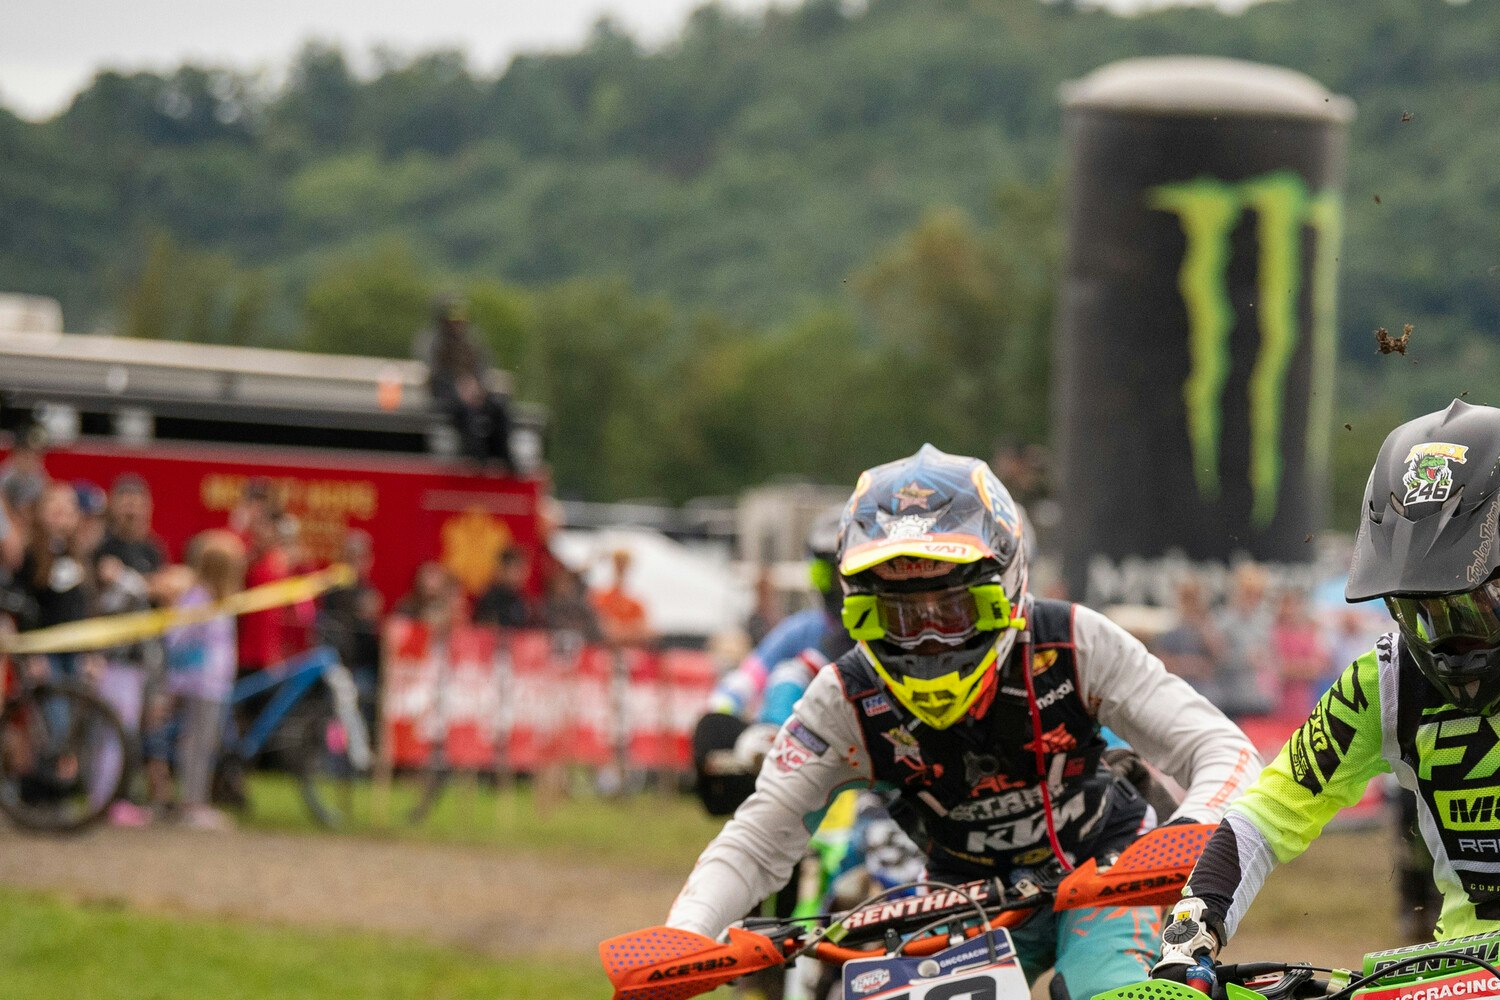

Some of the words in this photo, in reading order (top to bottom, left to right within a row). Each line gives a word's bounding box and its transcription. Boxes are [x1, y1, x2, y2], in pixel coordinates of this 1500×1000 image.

[1404, 481, 1449, 504] 246
[967, 791, 1086, 853] KTM
[843, 881, 989, 929] RENTHAL
